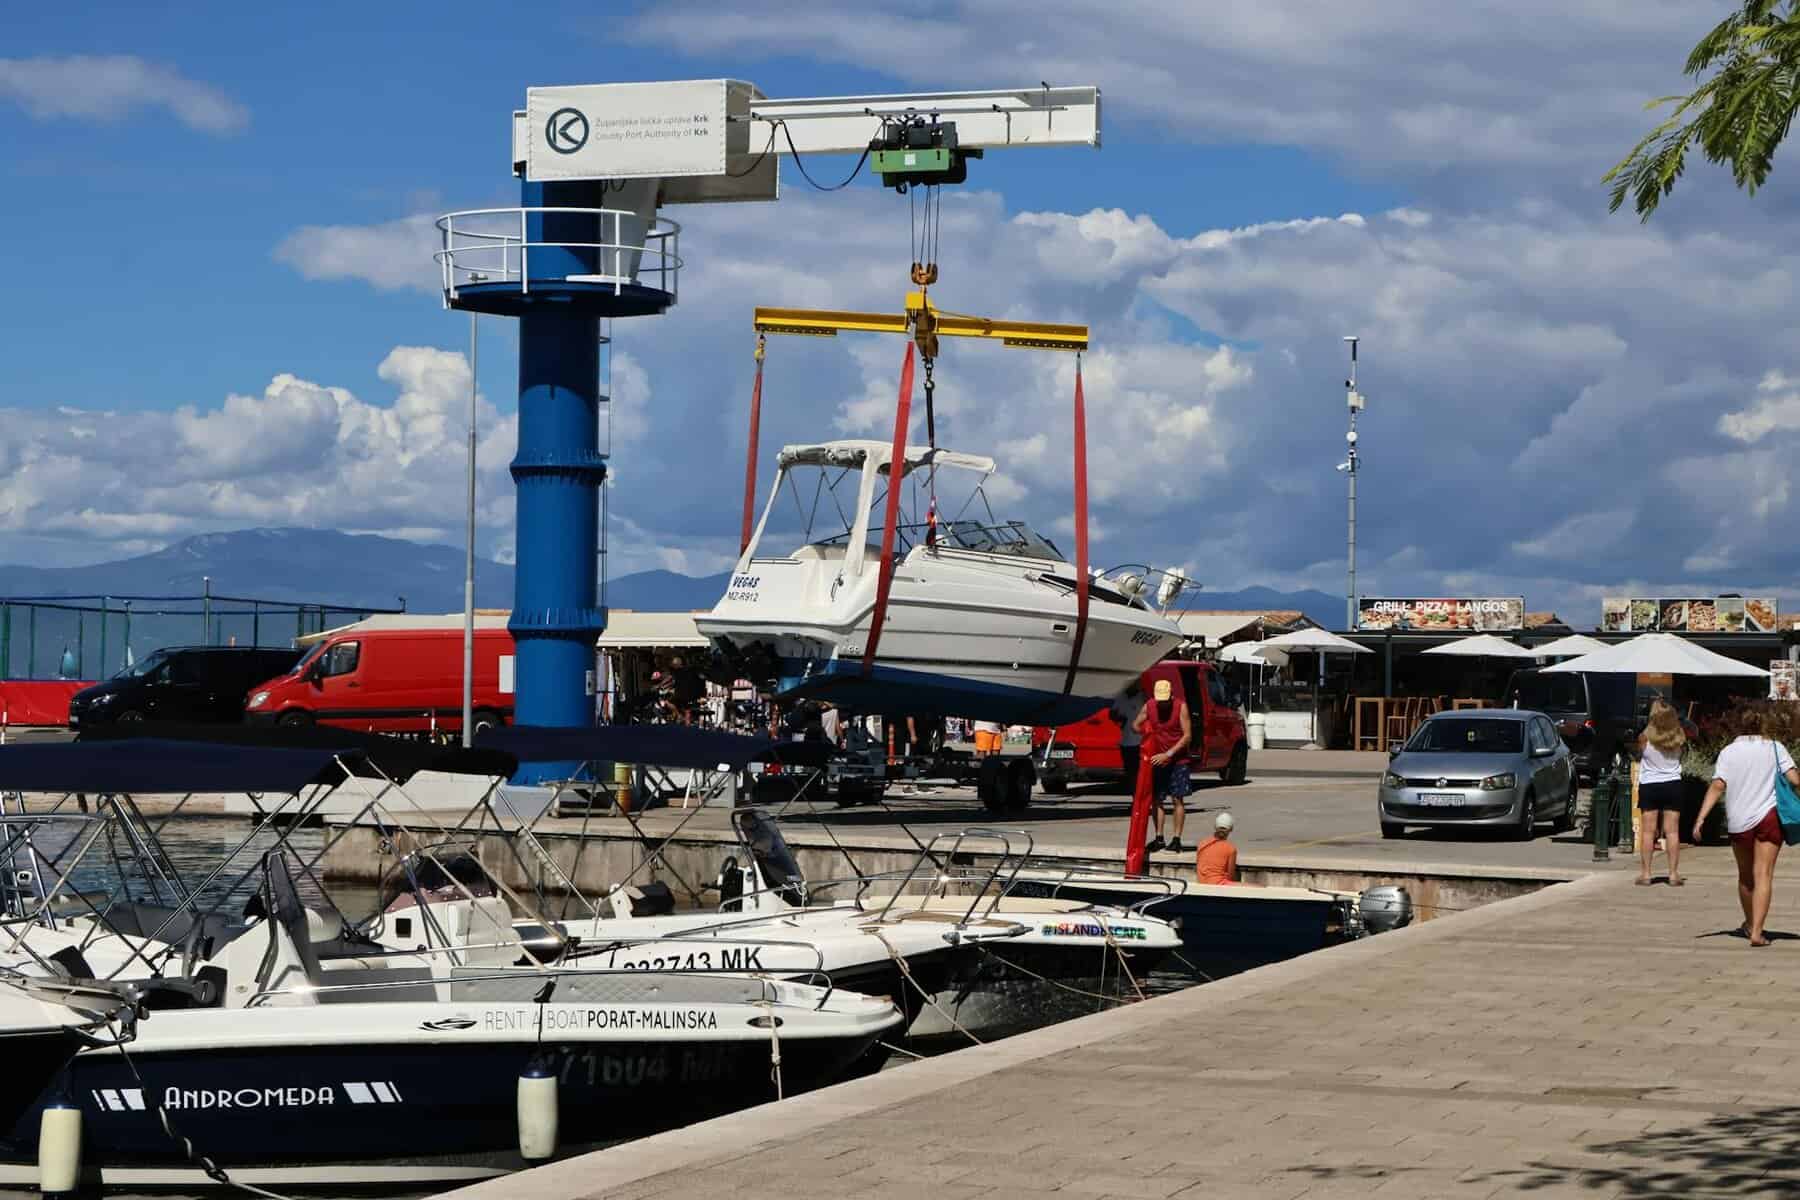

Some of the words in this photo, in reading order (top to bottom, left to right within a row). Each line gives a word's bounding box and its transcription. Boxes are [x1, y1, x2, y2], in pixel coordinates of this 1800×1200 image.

[694, 114, 709, 123] Krk
[595, 130, 623, 142] County
[625, 129, 642, 139] Port
[644, 128, 681, 139] Authority
[683, 128, 692, 137] of
[694, 128, 709, 137] Krk
[733, 576, 760, 588] VEGAS
[1416, 601, 1449, 612] PIZZA
[1456, 601, 1509, 612] LANGOS
[624, 952, 711, 969] 2743
[721, 947, 763, 969] MK
[485, 1011, 525, 1030] RENT
